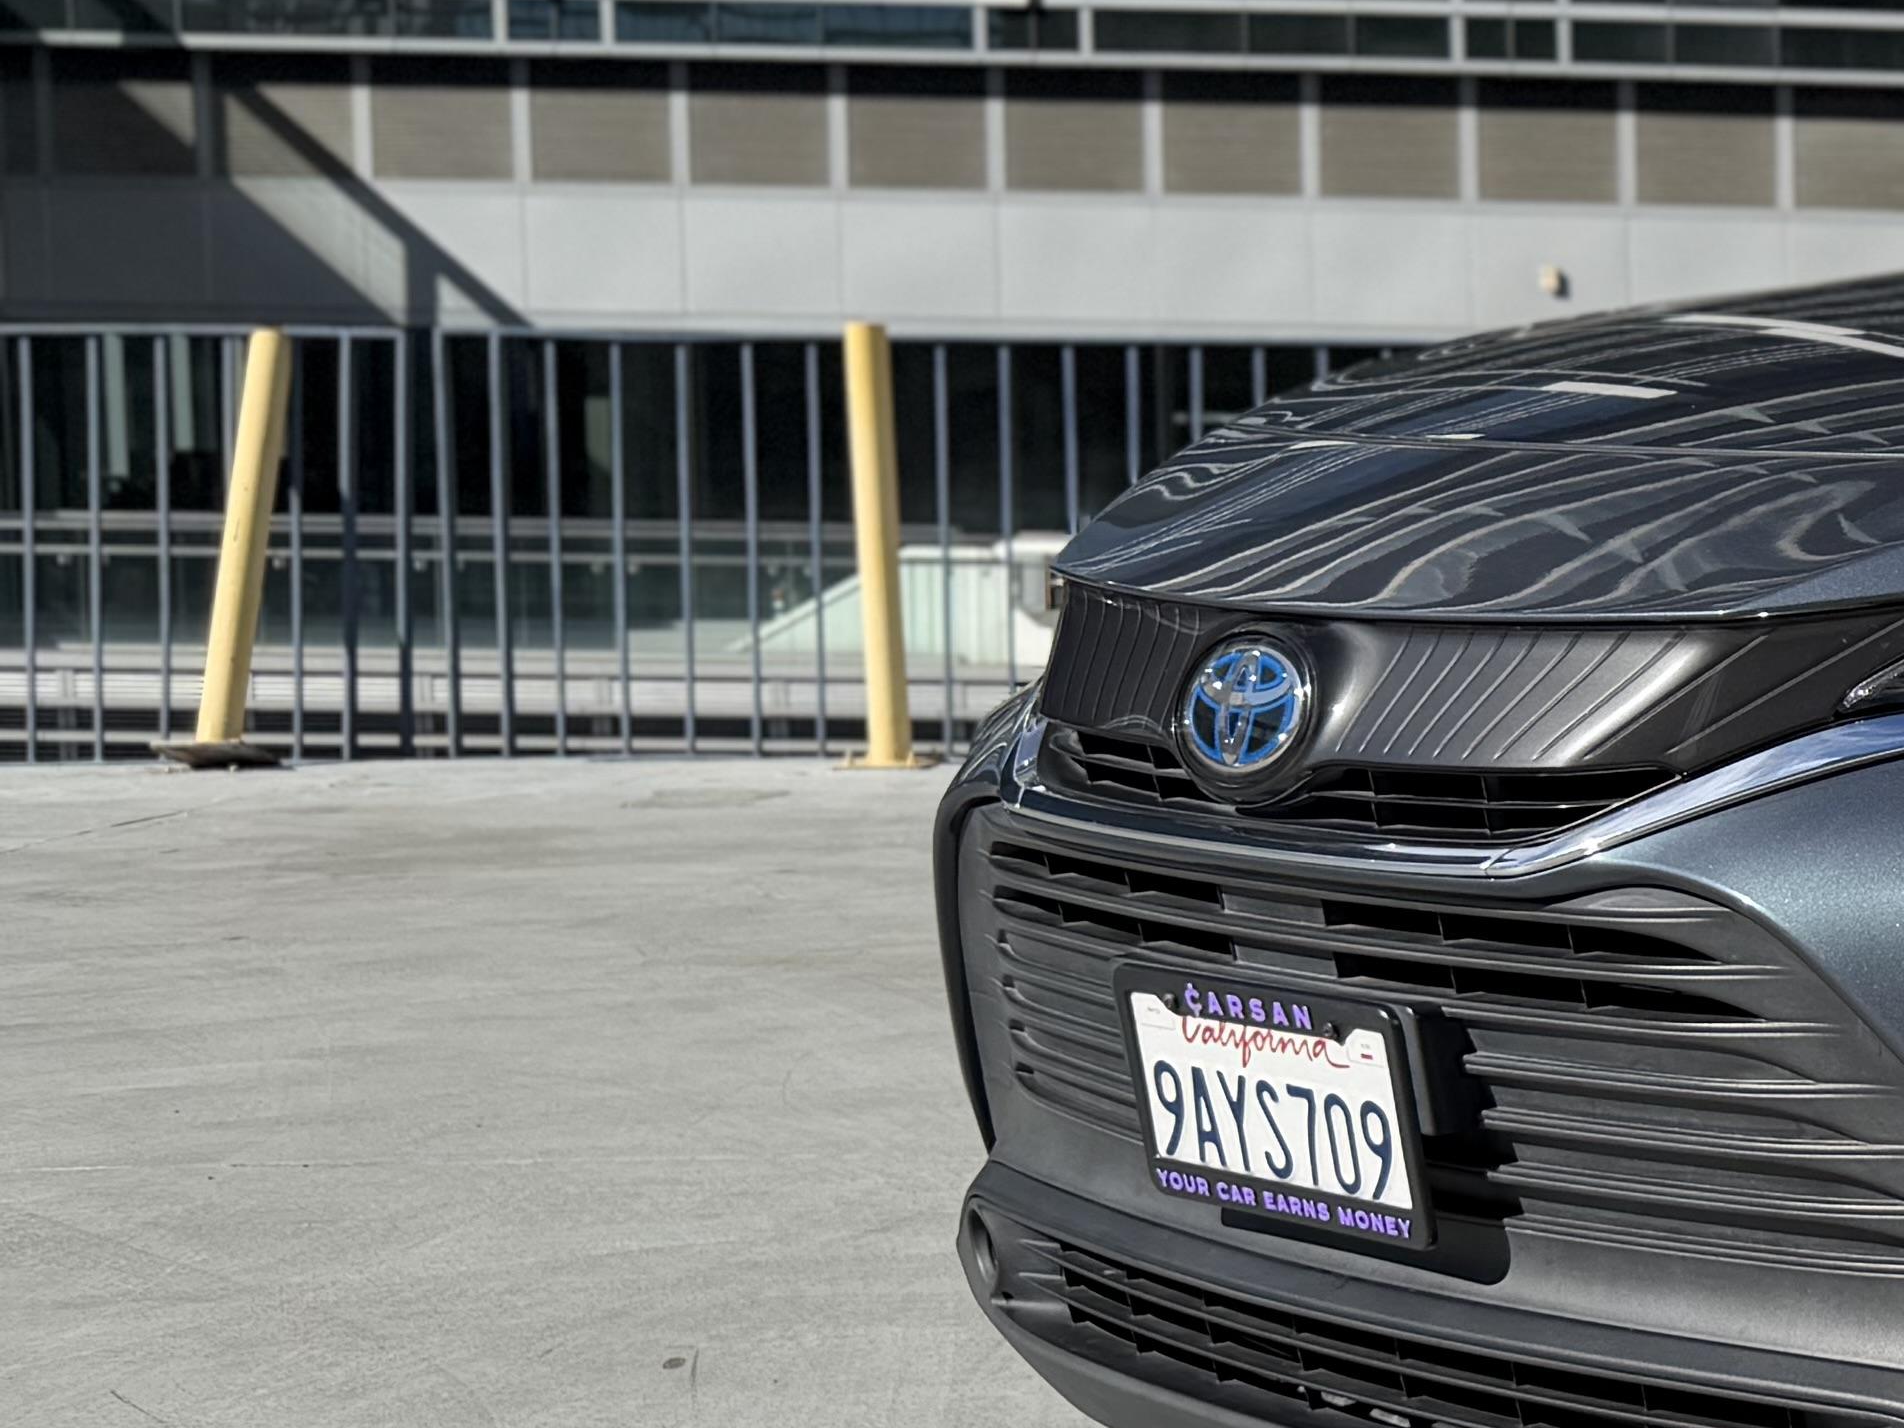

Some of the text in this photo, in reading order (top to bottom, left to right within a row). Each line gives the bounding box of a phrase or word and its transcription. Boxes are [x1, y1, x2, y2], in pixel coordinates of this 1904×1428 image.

[1153, 1060, 1393, 1201] 9AYS709
[1157, 1168, 1411, 1239] YOUR CAR EARNS MONEY
